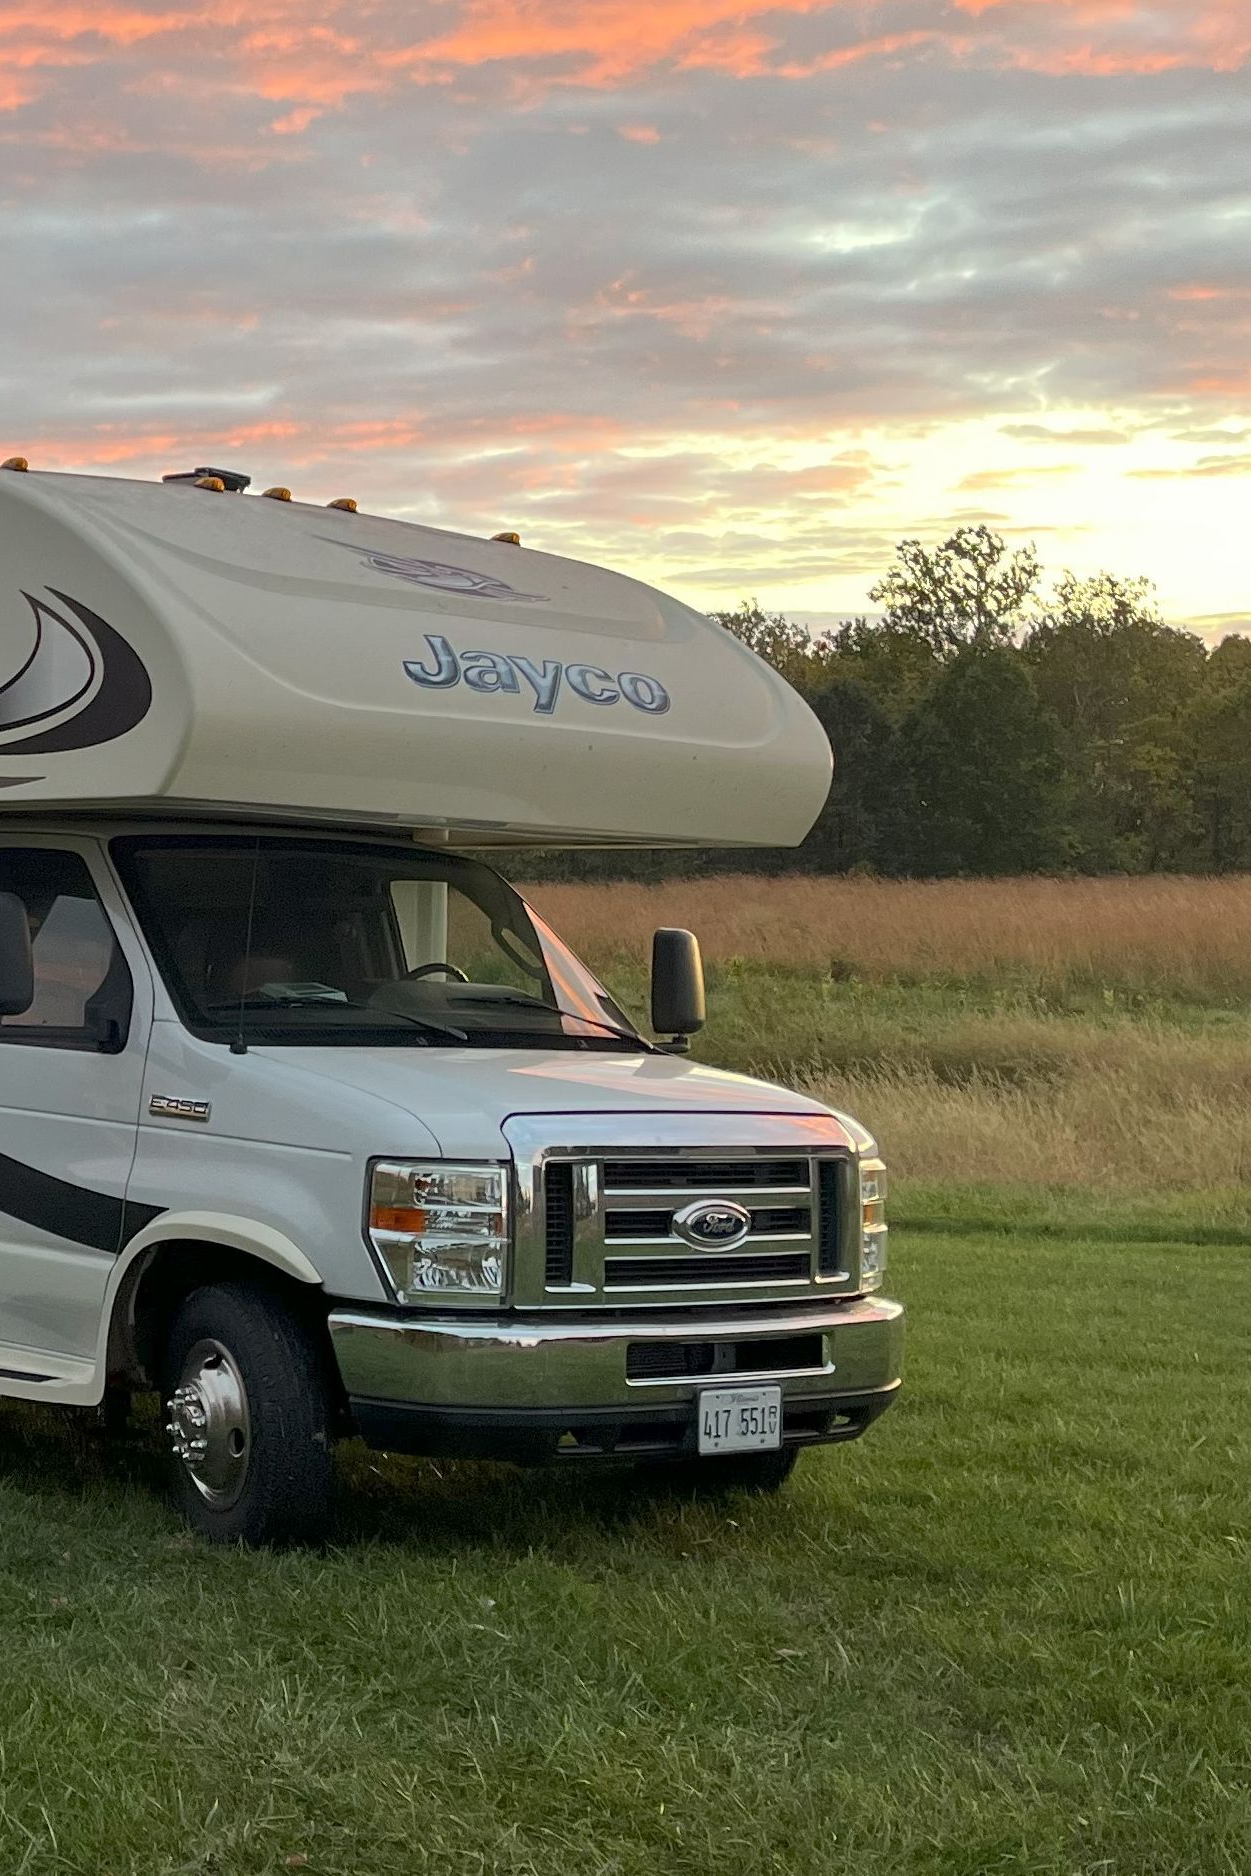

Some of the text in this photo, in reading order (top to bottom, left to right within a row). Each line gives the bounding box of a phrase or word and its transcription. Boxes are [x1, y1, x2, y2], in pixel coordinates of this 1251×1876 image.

[402, 634, 671, 715] Jayco
[703, 1213, 736, 1233] Ford
[703, 1409, 731, 1439] 417
[740, 1406, 768, 1436] 551
